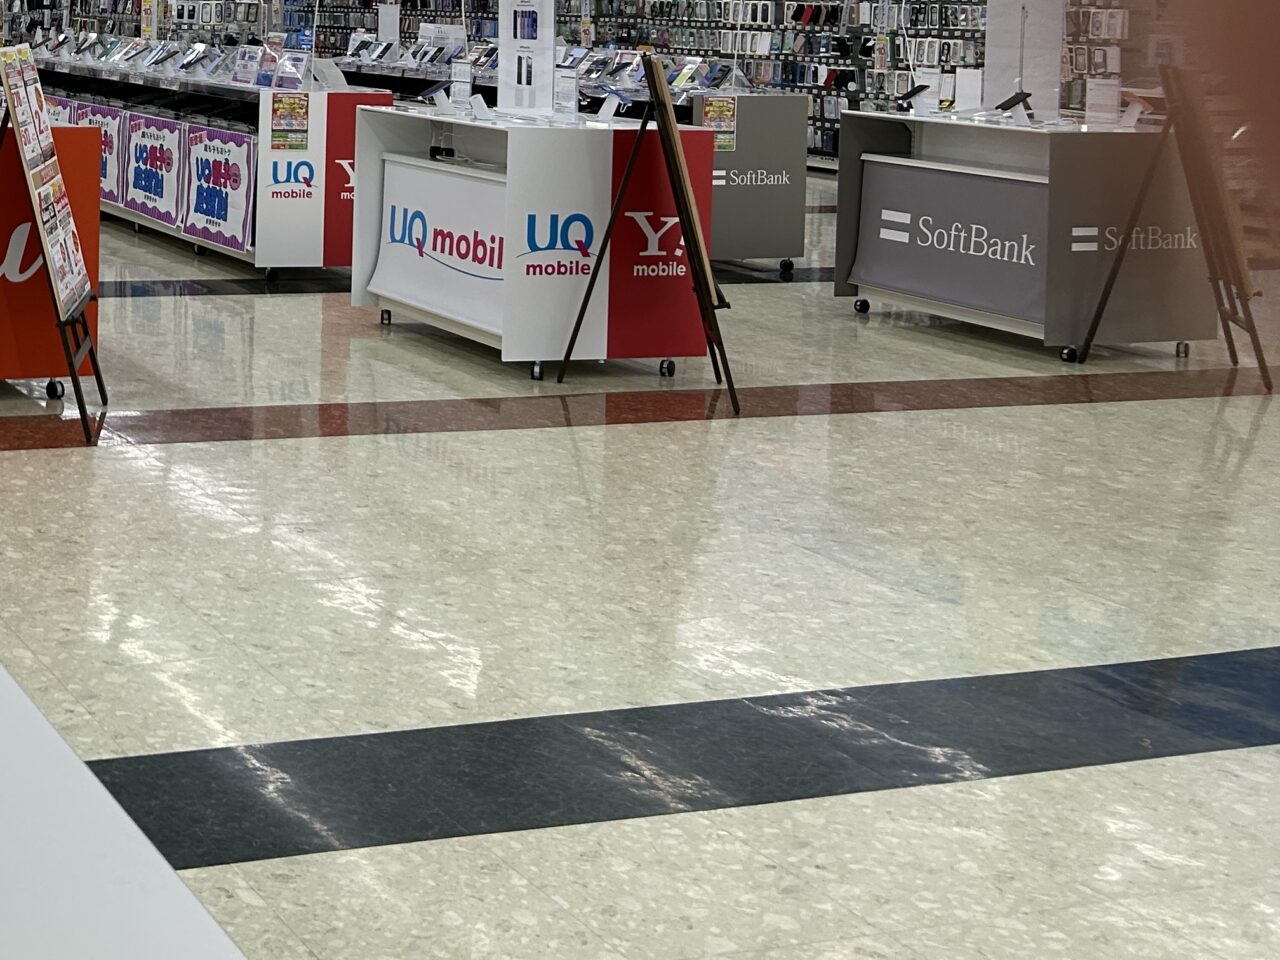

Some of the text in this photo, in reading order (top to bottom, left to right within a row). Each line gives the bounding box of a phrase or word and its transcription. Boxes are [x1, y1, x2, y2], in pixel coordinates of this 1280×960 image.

[272, 160, 315, 188] UQ
[729, 168, 790, 187] SoftBank
[271, 189, 313, 200] mobile
[388, 204, 428, 258] UQ
[526, 212, 595, 258] UQ
[916, 216, 1036, 266] SoftBank
[1104, 225, 1198, 251] SoftBank
[525, 260, 592, 277] mobile
[633, 262, 687, 277] mobile
